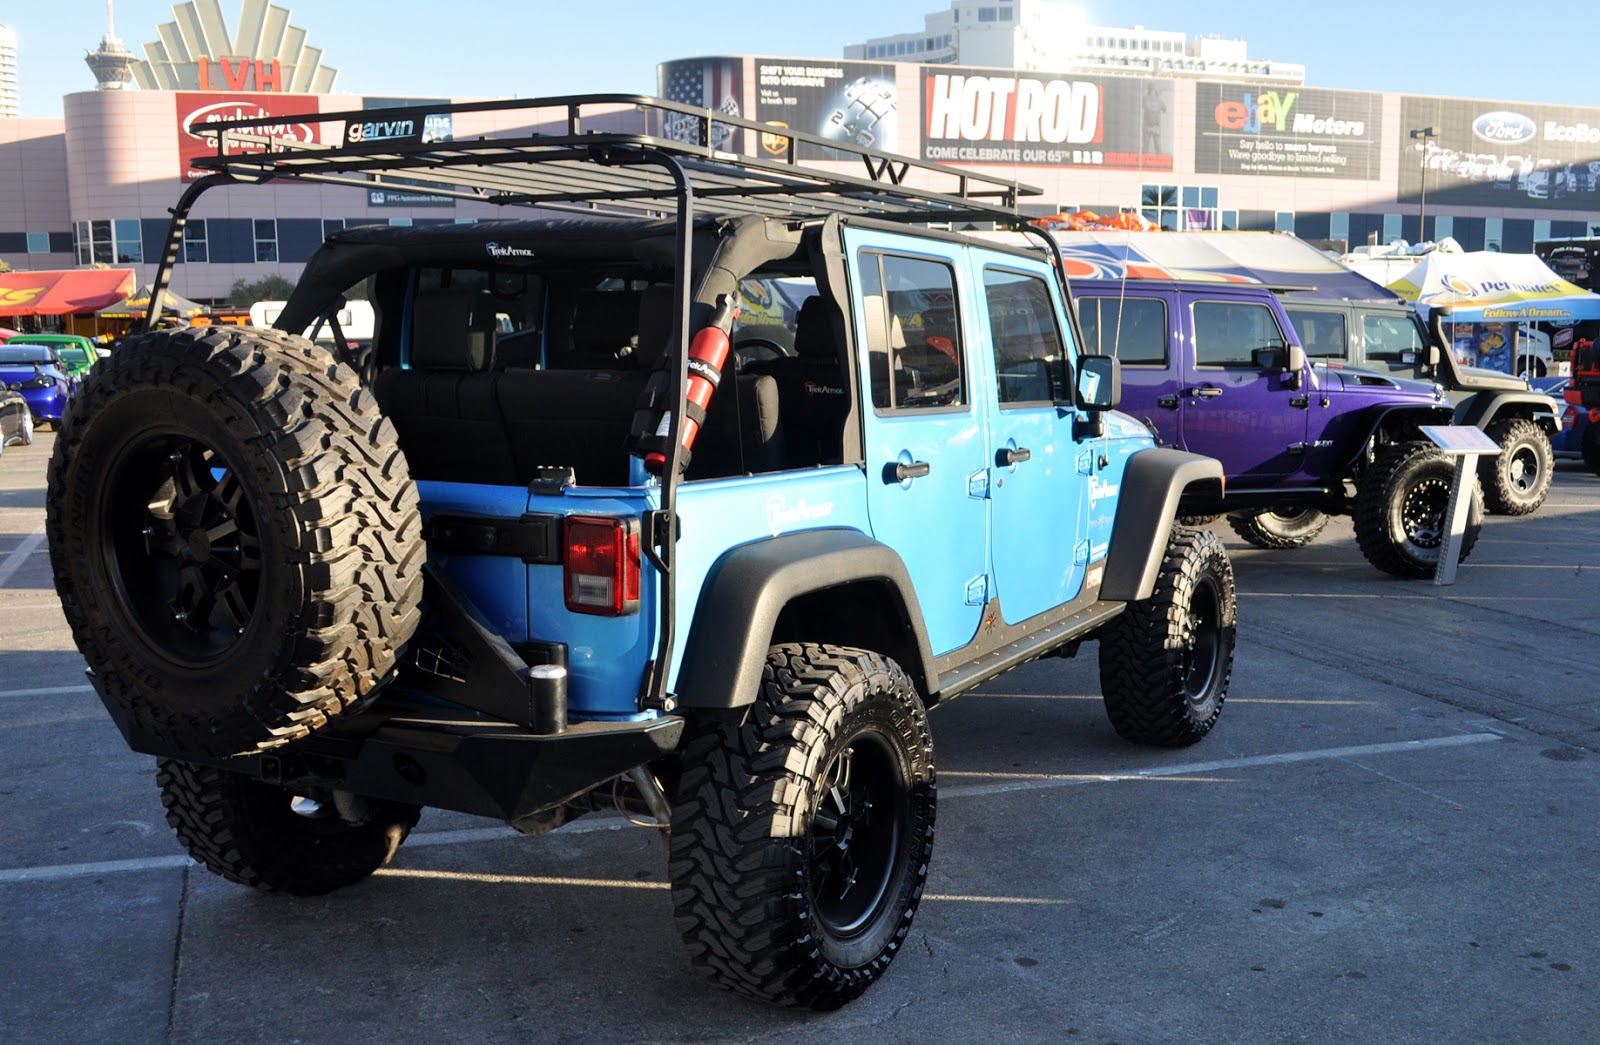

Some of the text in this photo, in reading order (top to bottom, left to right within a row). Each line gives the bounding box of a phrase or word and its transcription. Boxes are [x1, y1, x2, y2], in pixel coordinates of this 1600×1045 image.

[199, 57, 281, 91] LVH
[760, 65, 844, 78] SHIFT YOUR BUSINESS
[760, 75, 825, 87] INTO OVERDRIVE
[929, 75, 1098, 144] HOT ROD
[348, 120, 415, 142] garvin
[1293, 113, 1365, 136] Motors
[1485, 119, 1523, 140] Ford
[926, 146, 957, 160] COME
[958, 147, 1020, 162] CELEBRATE
[1023, 149, 1046, 162] OUR
[1240, 140, 1336, 155] Say hello to more buyers
[1229, 149, 1347, 166] Wave goodbye to limited selling
[1483, 308, 1517, 319] Follow
[1520, 308, 1527, 318] A
